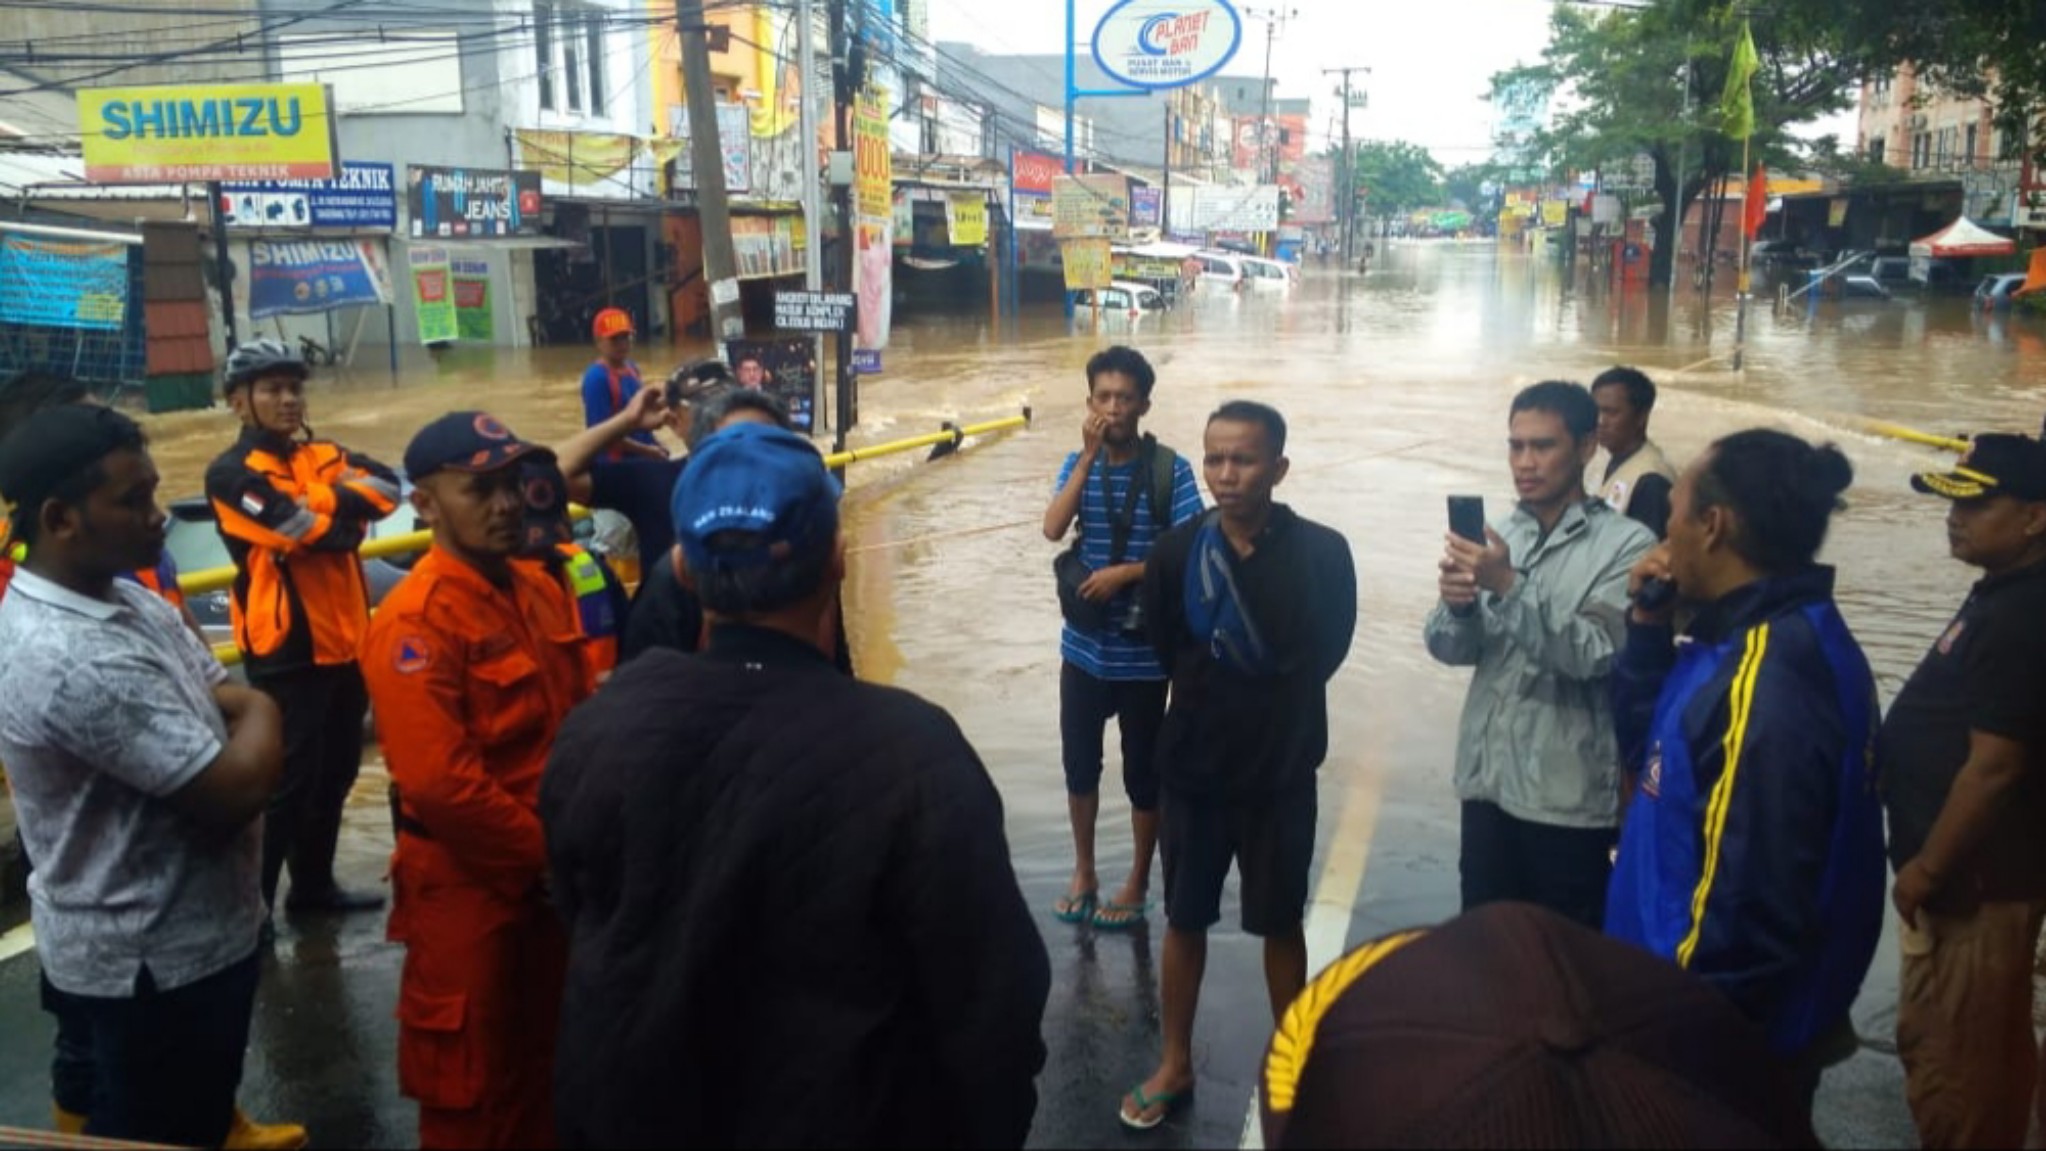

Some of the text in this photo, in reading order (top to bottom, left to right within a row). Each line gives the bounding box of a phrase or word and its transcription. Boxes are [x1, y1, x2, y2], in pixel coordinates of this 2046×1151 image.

[1155, 10, 1210, 42] PLANET
[1170, 34, 1198, 55] BAN
[101, 95, 302, 139] SHIMIZU
[122, 163, 290, 180] ASIA POMPA TEKNIK
[431, 174, 473, 193] RUMAH
[464, 200, 511, 220] JEANS
[253, 241, 356, 265] SHIMIZU
